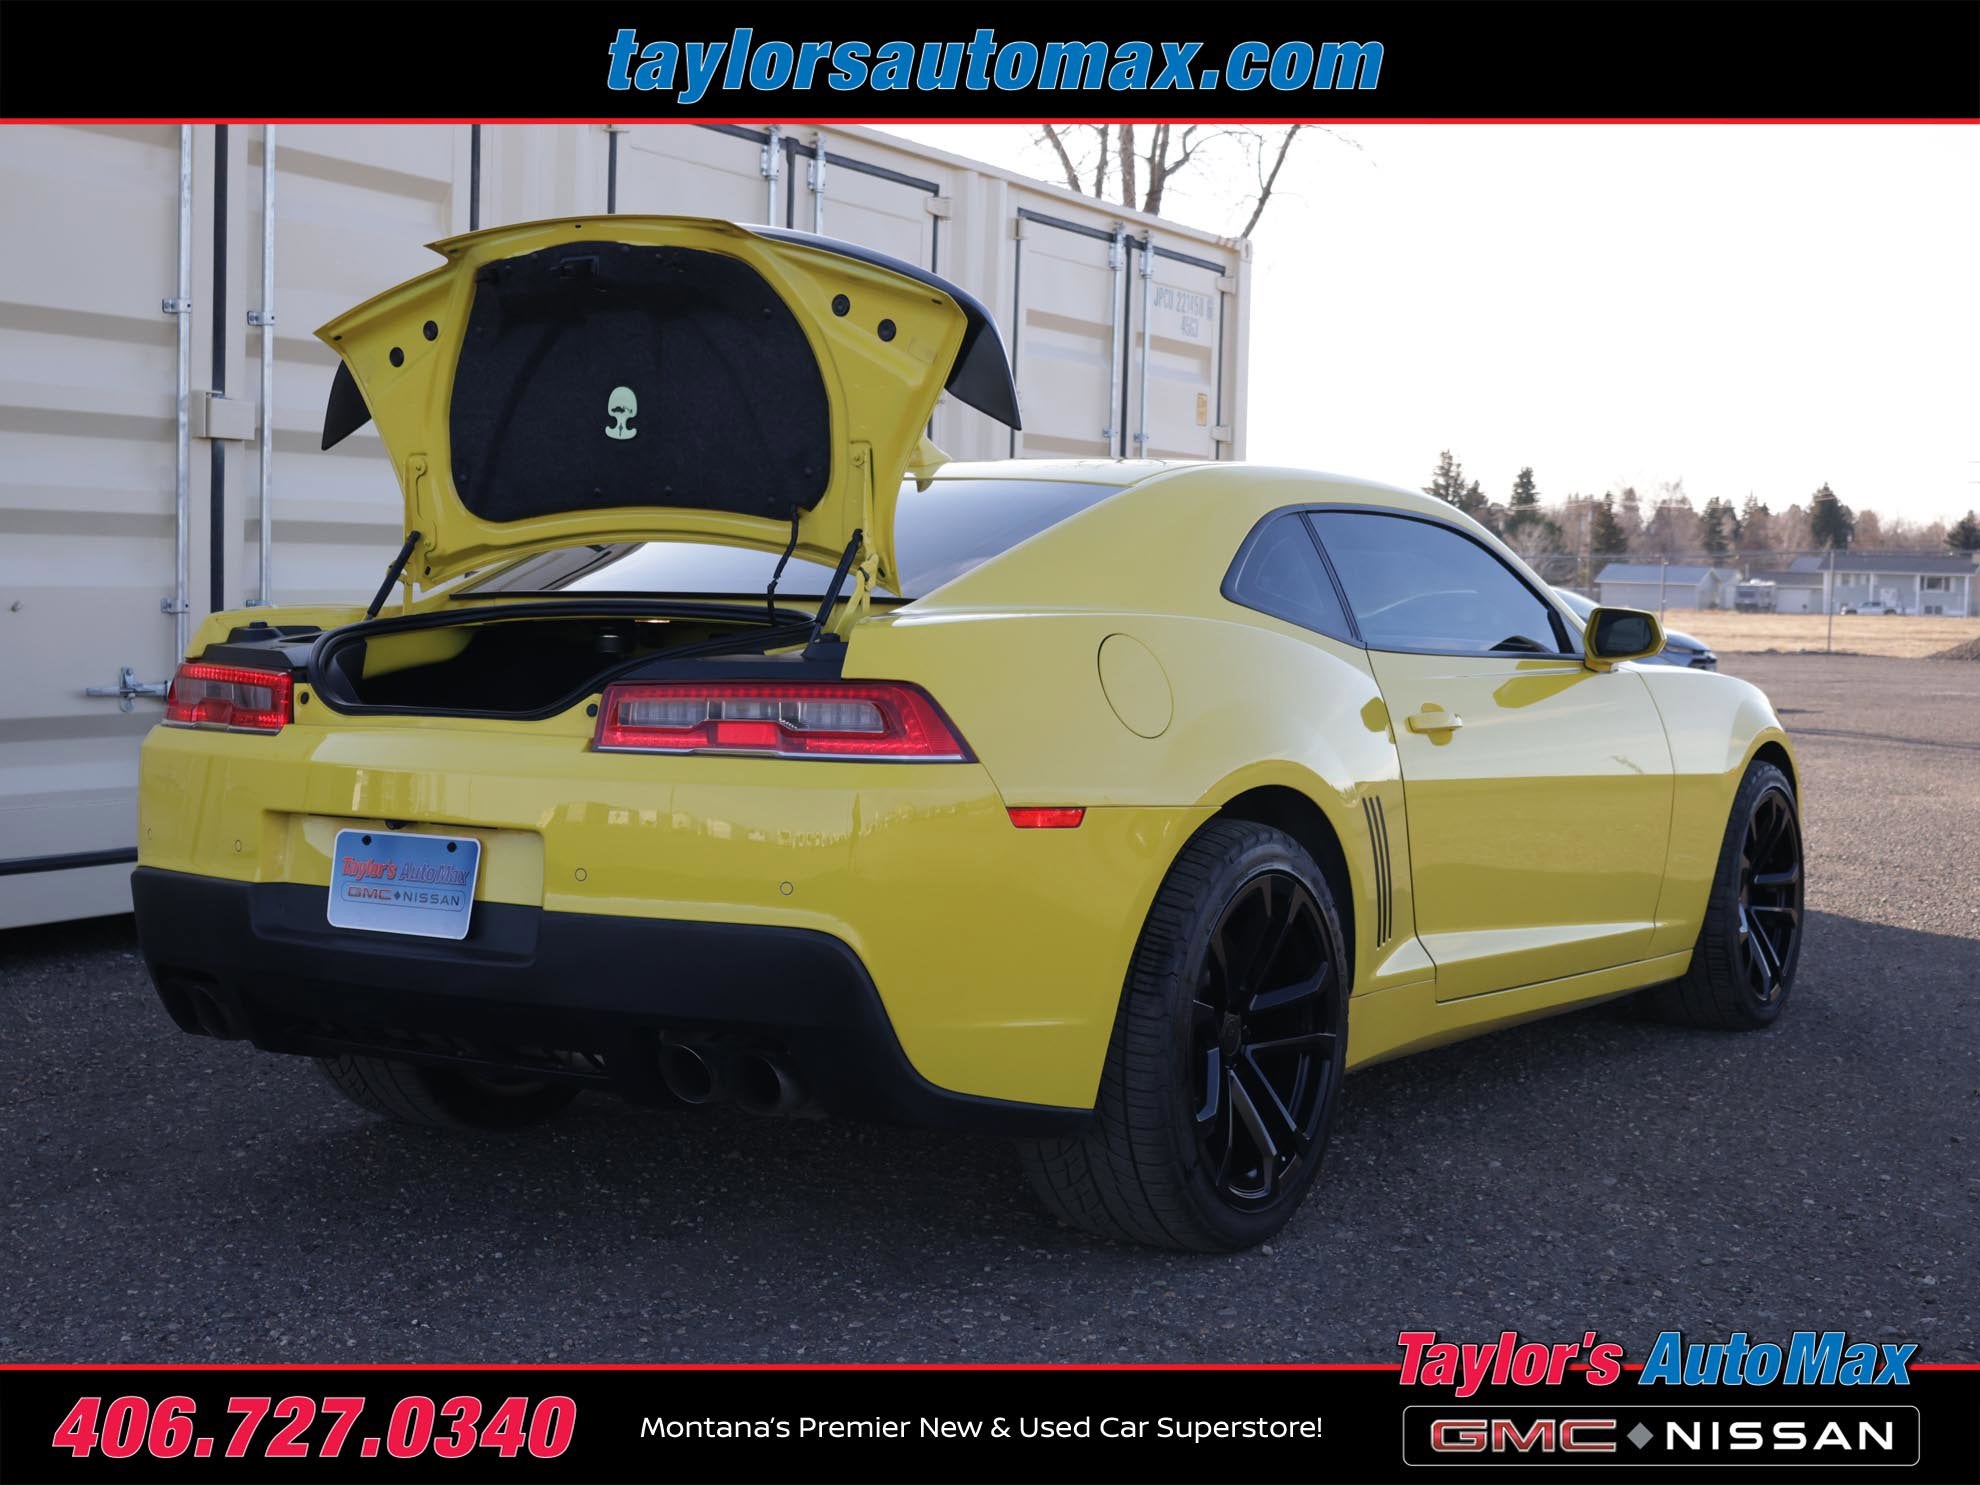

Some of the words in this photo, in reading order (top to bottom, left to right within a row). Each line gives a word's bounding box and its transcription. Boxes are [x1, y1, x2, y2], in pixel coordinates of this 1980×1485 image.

[342, 856, 397, 881] Taylor's
[398, 862, 469, 886] AutoMax
[348, 886, 392, 901] GMC
[402, 892, 460, 906] NISSAN
